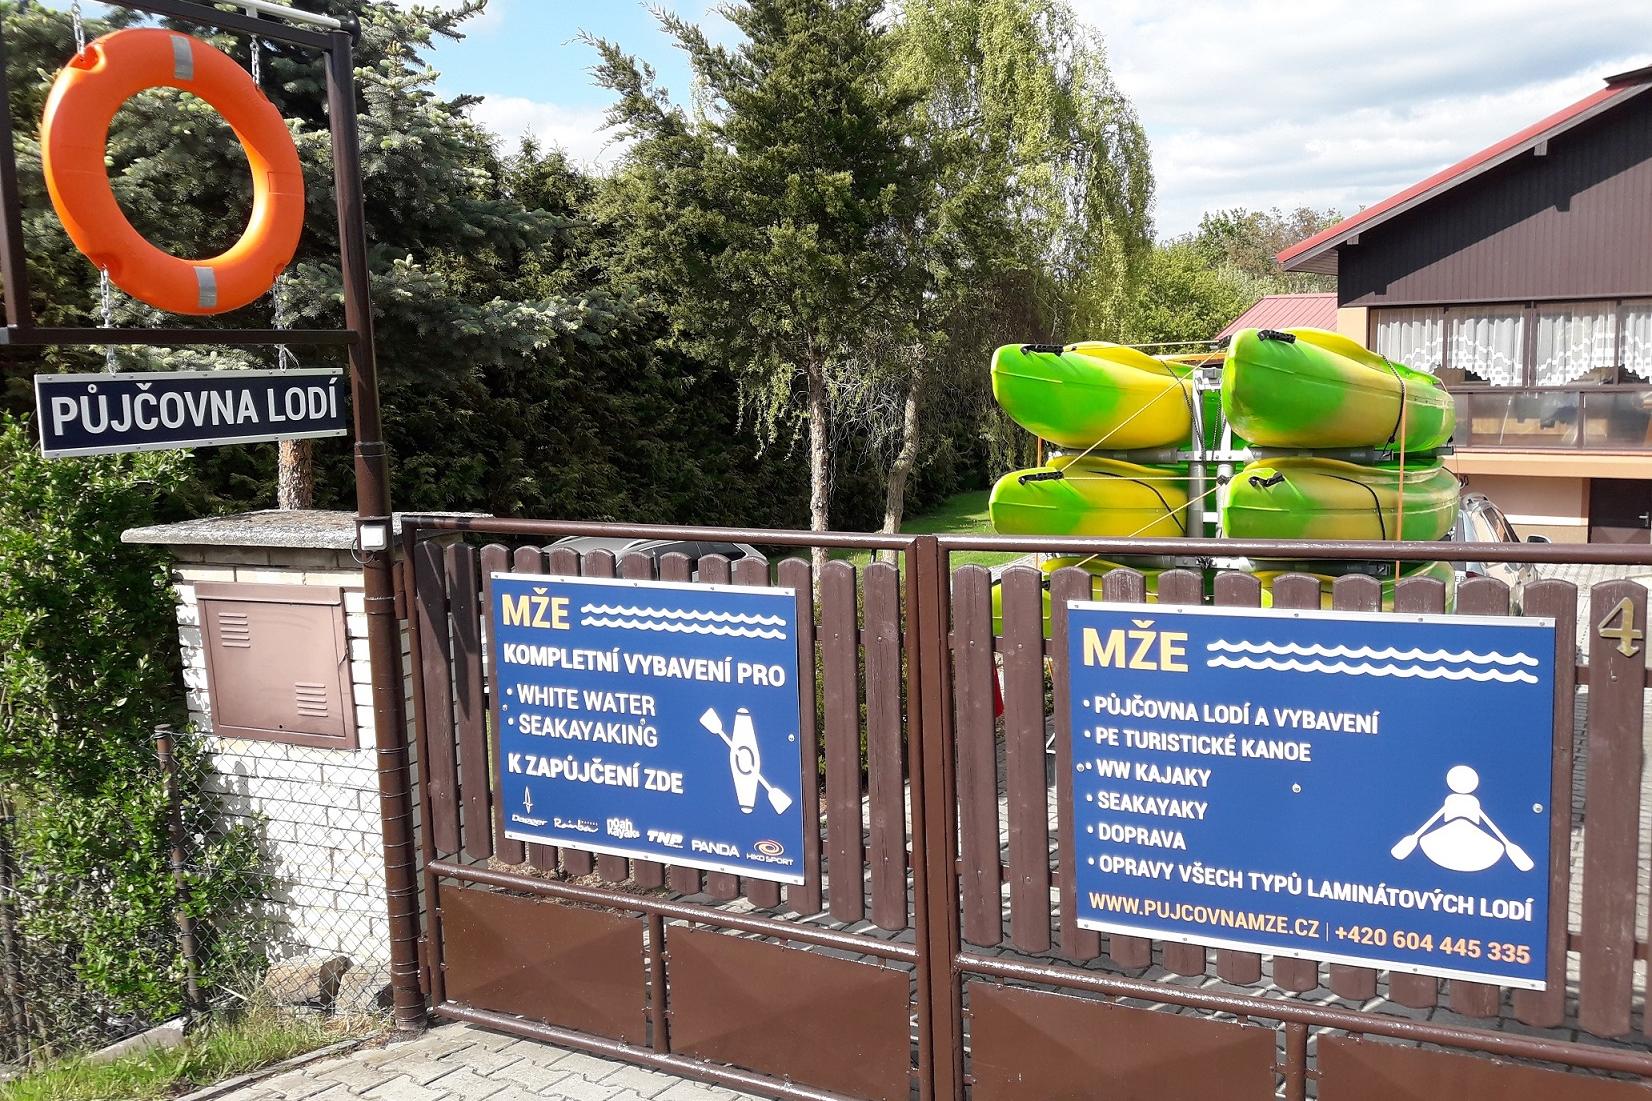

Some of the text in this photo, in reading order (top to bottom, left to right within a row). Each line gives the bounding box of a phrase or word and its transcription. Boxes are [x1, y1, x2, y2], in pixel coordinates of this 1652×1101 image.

[51, 377, 338, 436] PŮJČOVNA LODÍ
[502, 587, 570, 630] MŽE
[1597, 597, 1643, 657] 4
[504, 644, 785, 687] KOMPLETNÍ VYBAVENÍ PRO
[1083, 619, 1189, 672] MŽE
[517, 684, 655, 716] WHITE WATER
[1095, 693, 1380, 734] PŮJČOVNA LODÍ A VYBAVENÍ
[519, 715, 657, 748] SEAKAYAKING
[1096, 727, 1311, 762] PE TURISTICKÉ KANOE
[508, 753, 683, 794] K ZAPŮJČENÍ ZDE
[1097, 760, 1211, 788] WW KAJAKY
[1097, 792, 1208, 821] SEAKAYAKY
[691, 840, 740, 857] PANDA
[1098, 823, 1186, 851] DOPRAVA
[766, 856, 794, 865] SPORT
[1099, 855, 1534, 921] OPRAVY VŠECH TYPŮ LAMINÁTOVÝCH LODÍ
[1089, 892, 1531, 964] WWW.PUJCOVNAMZE.CZ +420 604 445 335
